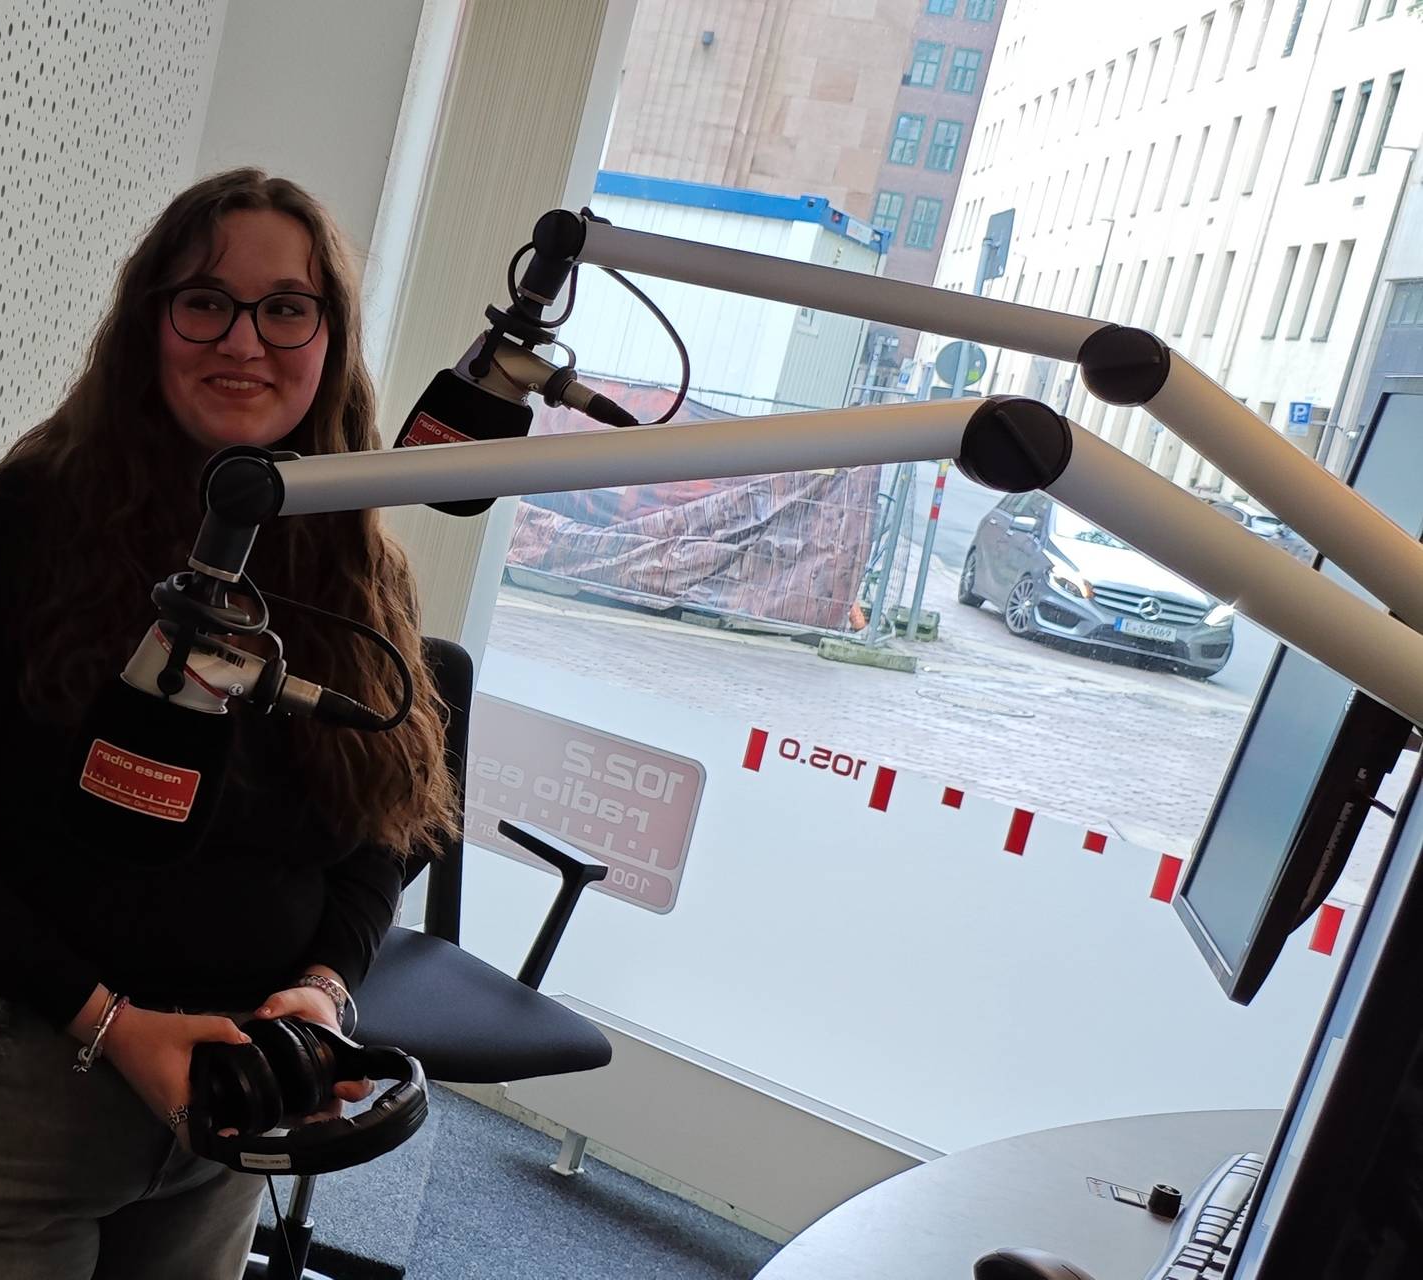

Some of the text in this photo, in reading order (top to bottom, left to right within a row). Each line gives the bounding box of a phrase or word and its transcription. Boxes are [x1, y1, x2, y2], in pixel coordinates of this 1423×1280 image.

[1293, 404, 1307, 422] P
[419, 419, 461, 442] radio es
[97, 749, 182, 785] radio essen
